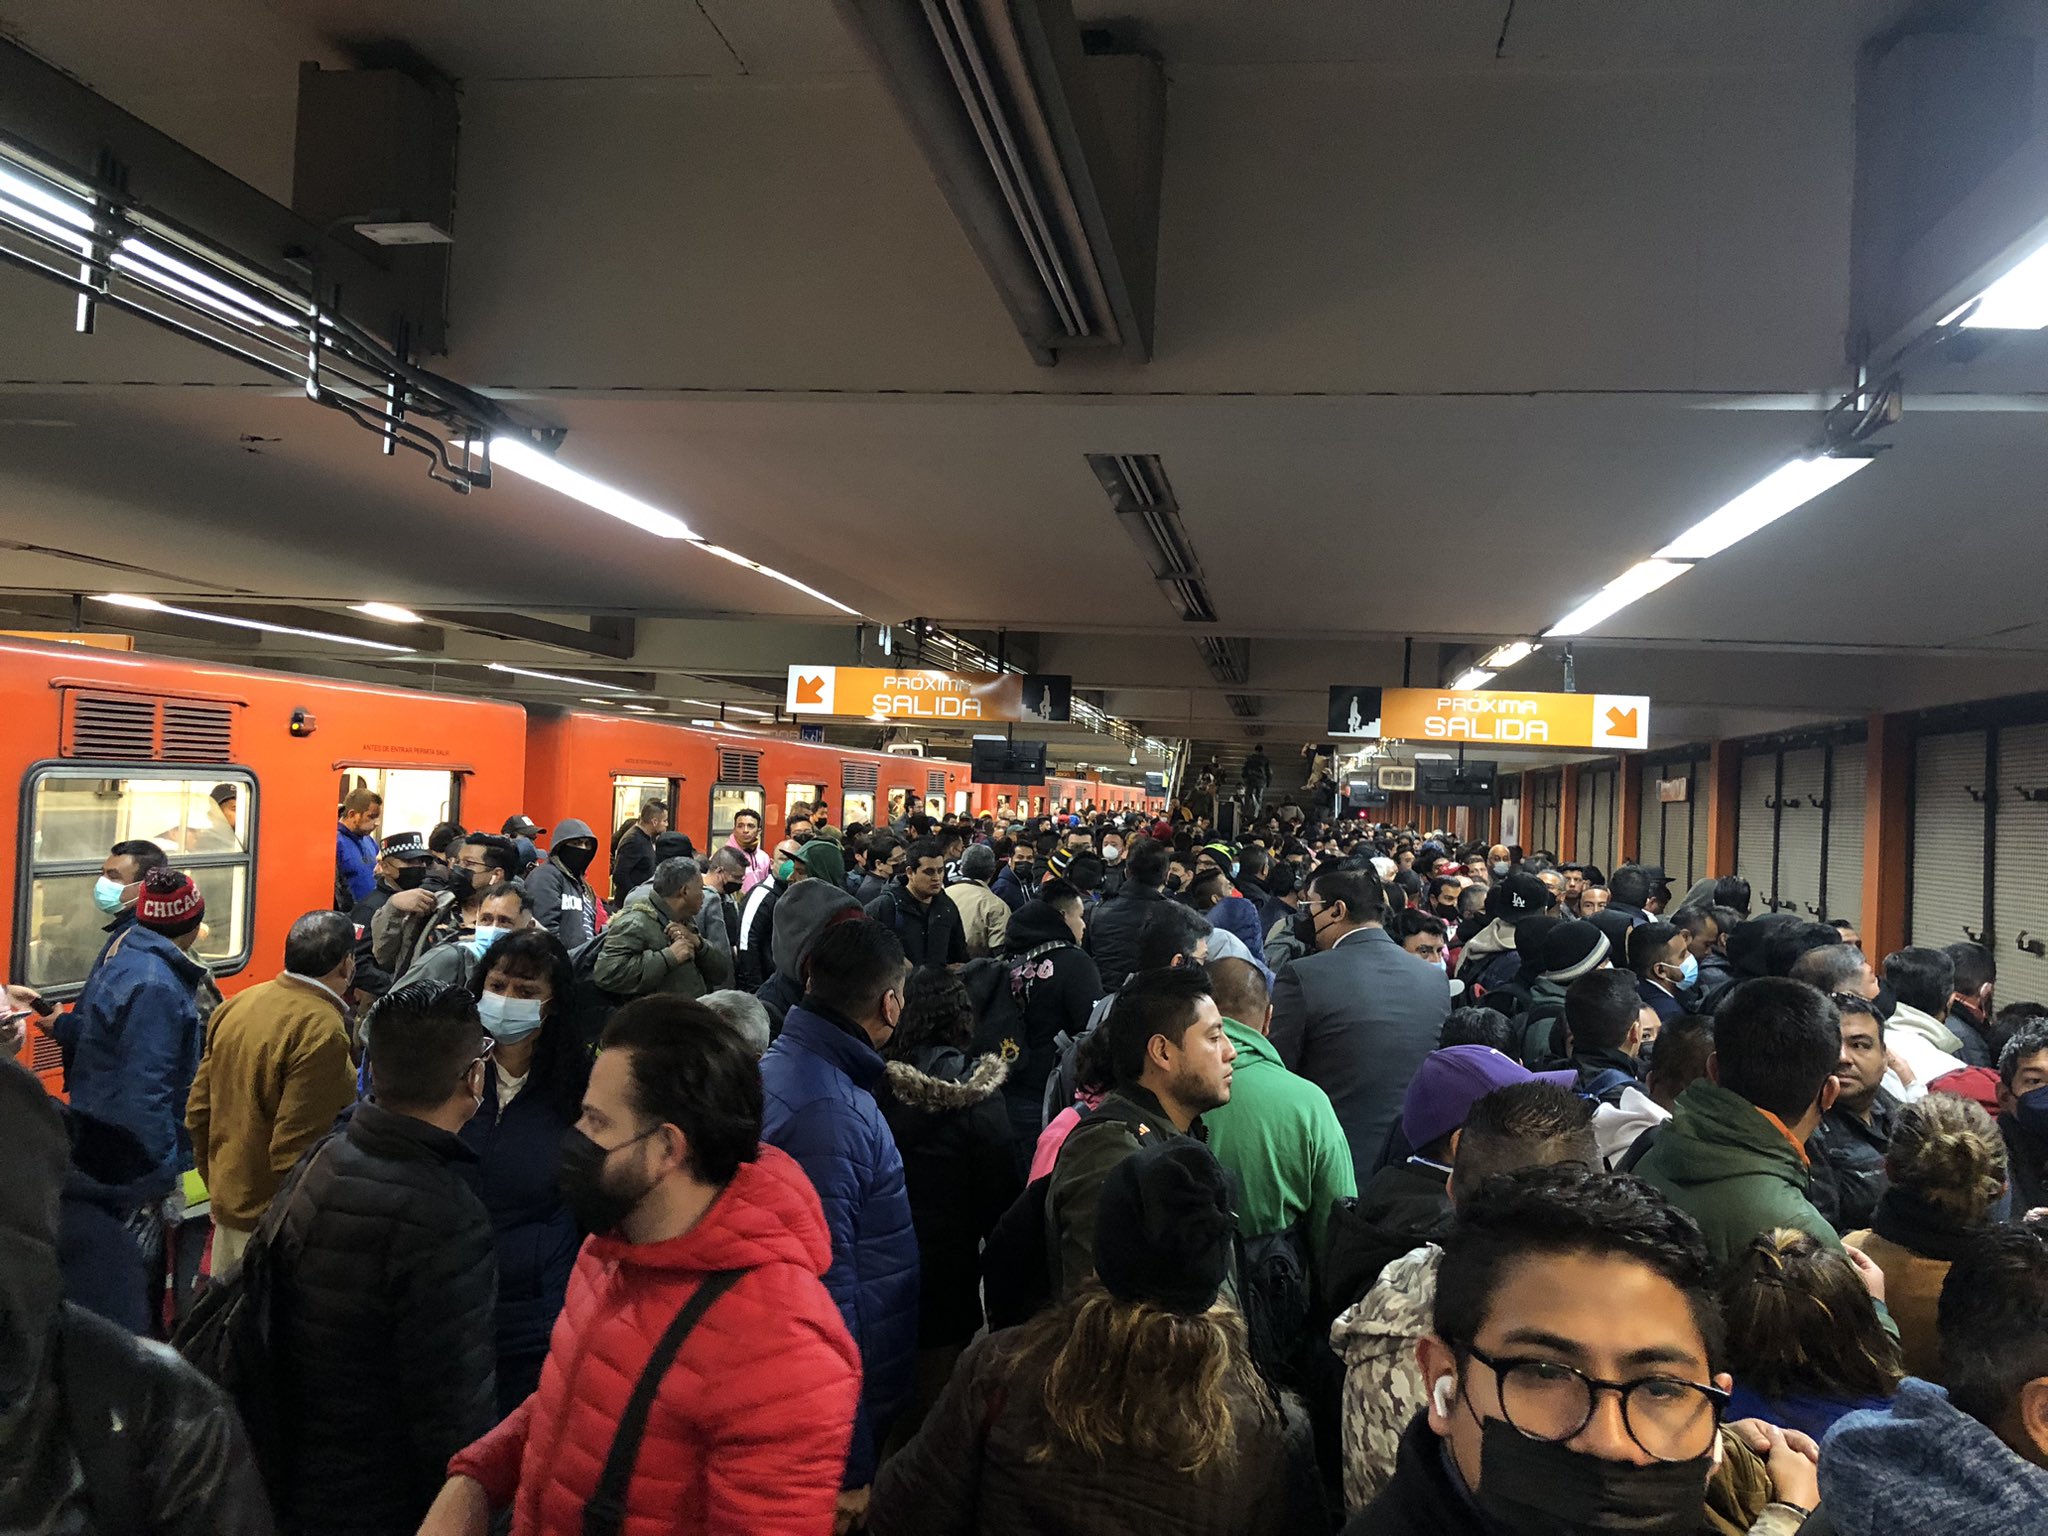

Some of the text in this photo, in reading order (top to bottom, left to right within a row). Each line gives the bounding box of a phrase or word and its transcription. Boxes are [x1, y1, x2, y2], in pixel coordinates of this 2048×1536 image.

[883, 674, 973, 692] PRÓXIMA
[872, 694, 982, 717] SALIDA
[1436, 694, 1538, 715] PRÓXIMA
[1424, 716, 1549, 741] SALIDA
[363, 744, 381, 752] ANTES
[144, 883, 201, 917] CHICAG
[1512, 892, 1525, 907] LA
